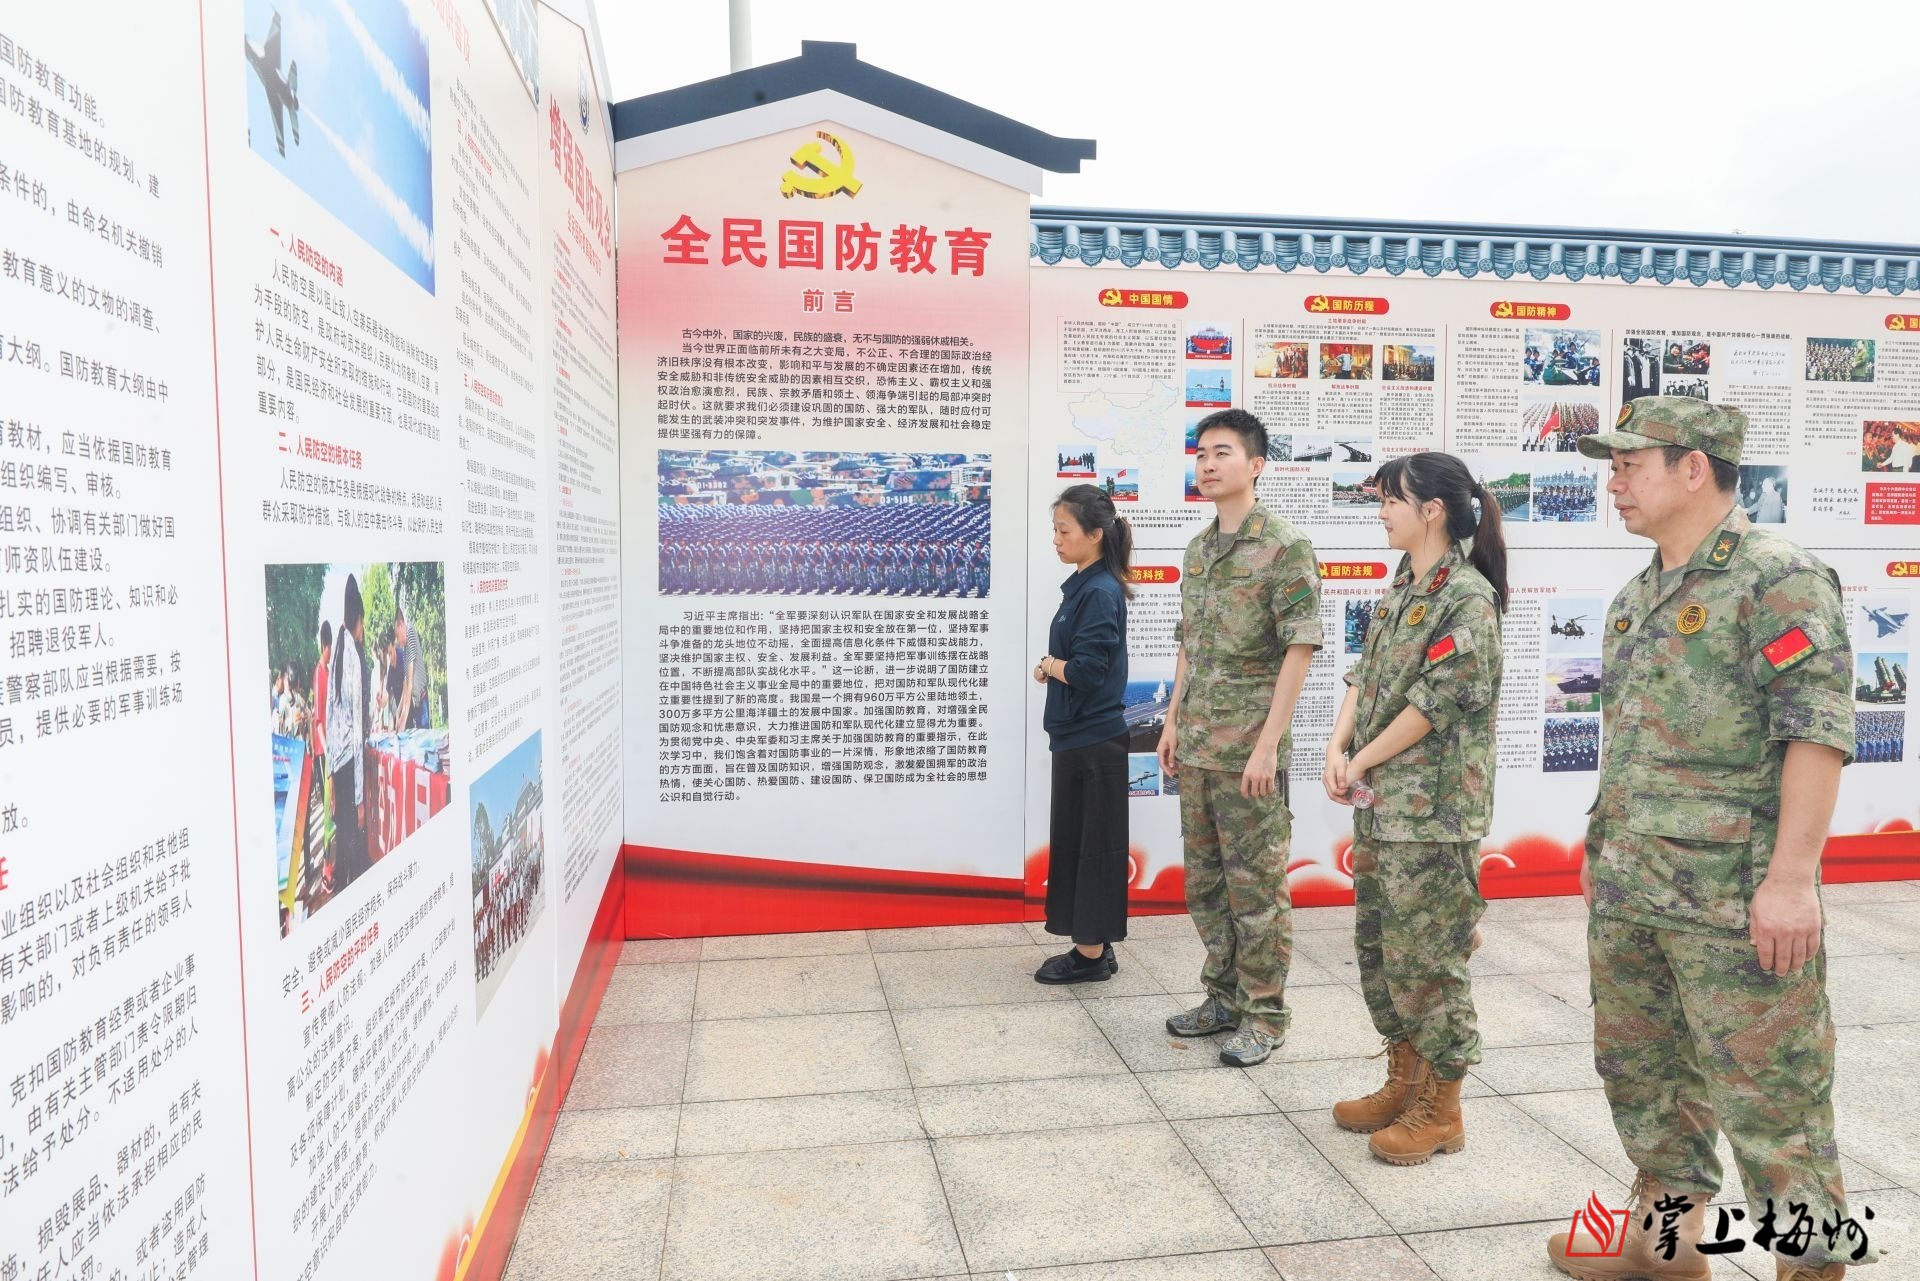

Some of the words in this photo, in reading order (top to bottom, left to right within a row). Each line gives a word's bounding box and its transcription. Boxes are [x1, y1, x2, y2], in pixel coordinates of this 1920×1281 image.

[0, 33, 105, 128] 国防教育功能。
[549, 93, 612, 259] 增强国防观念
[270, 227, 344, 288] 一、人民防空的内涵
[661, 214, 992, 276] 全民国防教育
[3, 248, 160, 334] 教育意义的文物的调查、
[802, 289, 855, 313] 前言
[1129, 293, 1173, 306] 中国国情
[1332, 299, 1375, 312] 国防历程
[1516, 305, 1557, 318] 国防精神
[1909, 317, 1920, 329] 国
[258, 389, 300, 424] 重要内容。
[0, 418, 171, 472] 教材，应当依据国防教育
[278, 429, 362, 470] 二、人民防空的根本任务
[657, 429, 763, 440] 提供坚强有力的保障。
[1, 460, 121, 499] 组织编写、审核。
[0, 505, 175, 539] 组织、协调有关部门做好国
[0, 545, 110, 573] 师资队伍建设。
[1131, 569, 1165, 581] 防科技
[1331, 564, 1373, 577] 国防法规
[1909, 564, 1920, 575] 国
[0, 584, 177, 618] 扎实的国防理论、知识和必
[9, 622, 114, 658] 招聘退役军人。
[0, 650, 181, 706] 警察部队应当根据需要，按
[2, 802, 28, 834] 放。
[1, 827, 190, 940] 业组织以及社会组织和其他组
[0, 857, 191, 983] 有关部门或者上级机关给予批
[0, 889, 192, 1025] 影响的，对负有责任的领导人
[301, 920, 378, 1016] 三、人民防空的平时任务
[0, 985, 197, 1160] ，由有关主管部门责令限期归
[3, 1016, 198, 1198] 法给予处分。不适用处分的人
[28, 1110, 203, 1281] 任人应当依法承担相应的民
[72, 1255, 102, 1281] 罚。
[168, 1232, 209, 1281] 安管理
